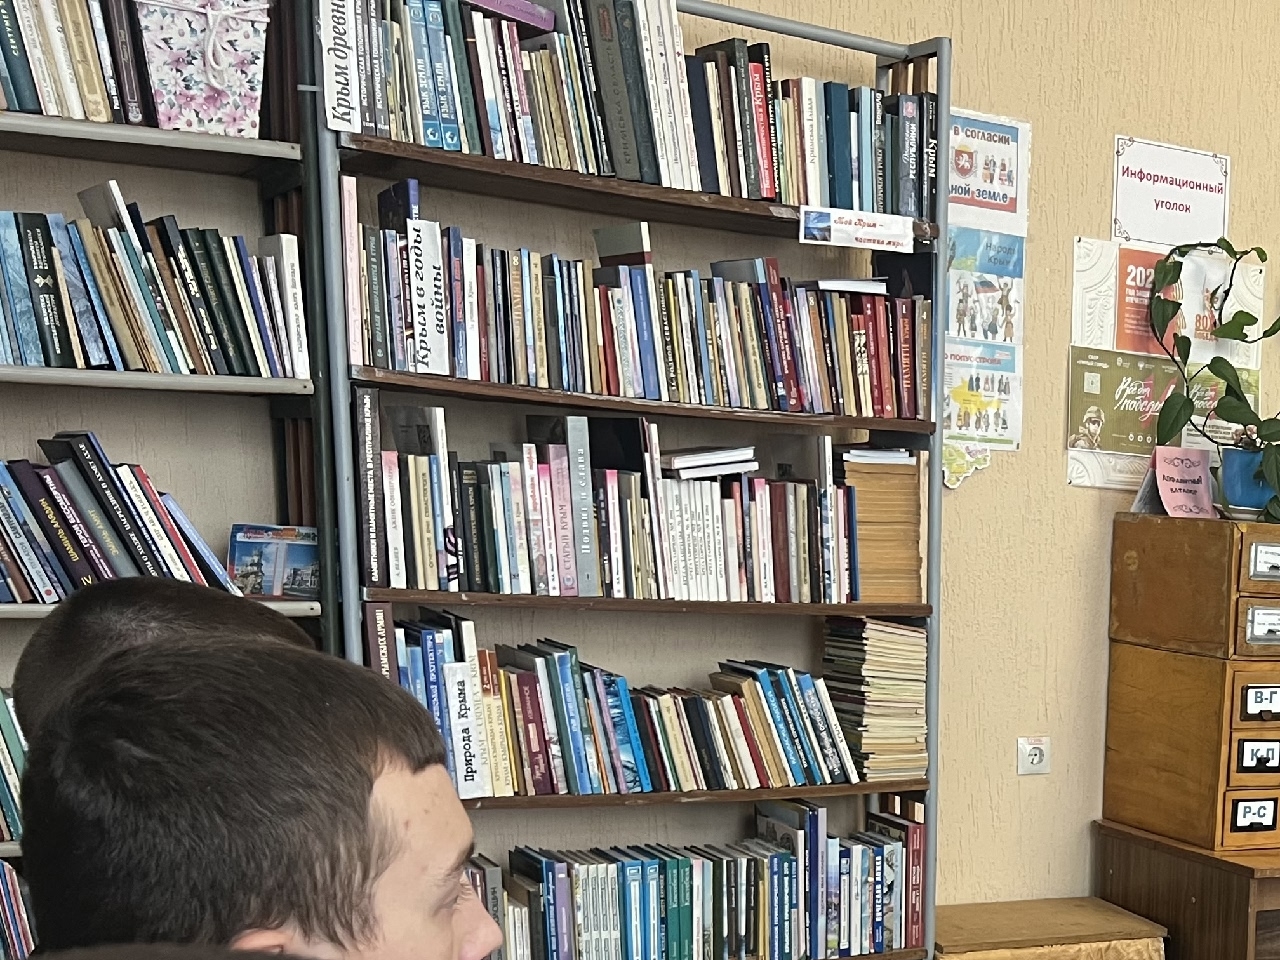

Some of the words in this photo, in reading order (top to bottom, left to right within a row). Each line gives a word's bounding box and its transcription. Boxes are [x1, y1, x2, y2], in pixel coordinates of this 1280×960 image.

[331, 0, 352, 60] древн
[417, 59, 428, 88] ЗЕМЛИ
[435, 62, 446, 91] ЗЕМЛИ
[753, 73, 763, 106] Крым
[332, 65, 356, 124] Крым
[421, 91, 430, 115] ЯЗЫК
[439, 95, 449, 118] ЯЗЫК
[965, 128, 1010, 145] согласии
[924, 138, 938, 178] Крым
[949, 183, 970, 197] ной
[976, 188, 1008, 203] земле
[1122, 165, 1224, 194] Информационный
[1154, 199, 1190, 213] уголок
[411, 227, 423, 282] годы
[1126, 264, 1155, 288] 202
[416, 287, 424, 298] в
[431, 265, 444, 334] войны
[416, 303, 431, 368] Крым
[902, 343, 911, 388] ПАМЯТИ
[367, 470, 375, 493] МЕСТА
[577, 448, 586, 487] слава
[39, 497, 61, 529] АЛЯДИН
[368, 493, 376, 532] ПАМЯТНЫЕ
[558, 504, 568, 530] КРЫМ
[52, 528, 79, 562] ШАМИЛЬ
[371, 539, 379, 581] ПАМЯТНИКИ
[561, 534, 572, 570] СТАРЫЙ
[457, 679, 471, 719] Крыма
[1254, 690, 1278, 704] В-Г
[461, 727, 477, 782] Природа
[1242, 806, 1267, 818] Р-С
